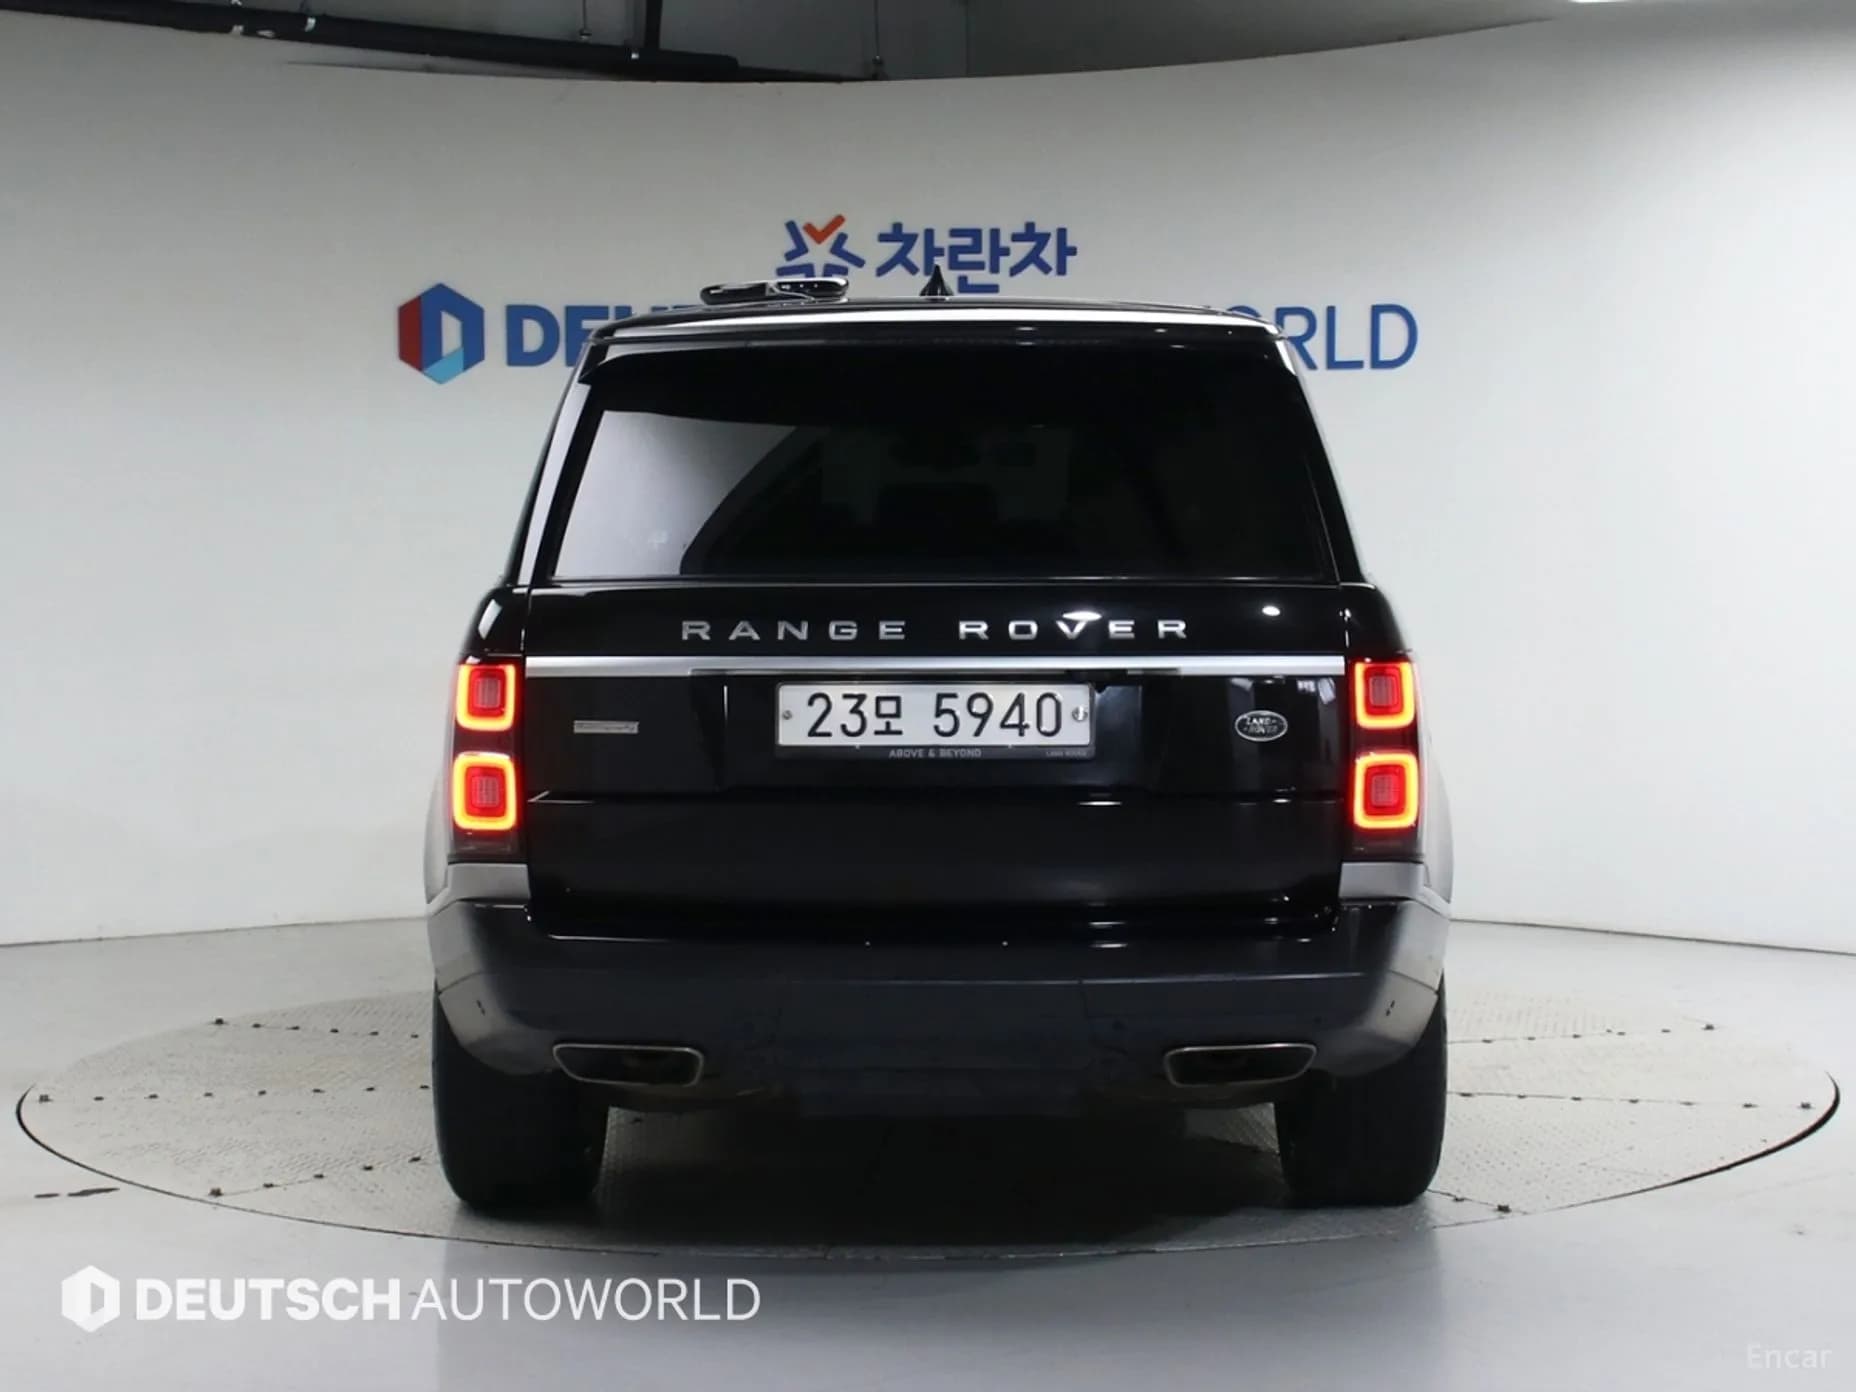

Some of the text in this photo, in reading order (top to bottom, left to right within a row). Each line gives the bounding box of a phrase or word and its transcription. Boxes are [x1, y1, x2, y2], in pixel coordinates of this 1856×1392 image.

[875, 221, 1078, 294] 차란차
[681, 618, 1188, 641] RANGE ROVER
[807, 692, 1063, 738] 23모 5940
[888, 748, 925, 759] ABOVE
[939, 748, 982, 759] BEYOND
